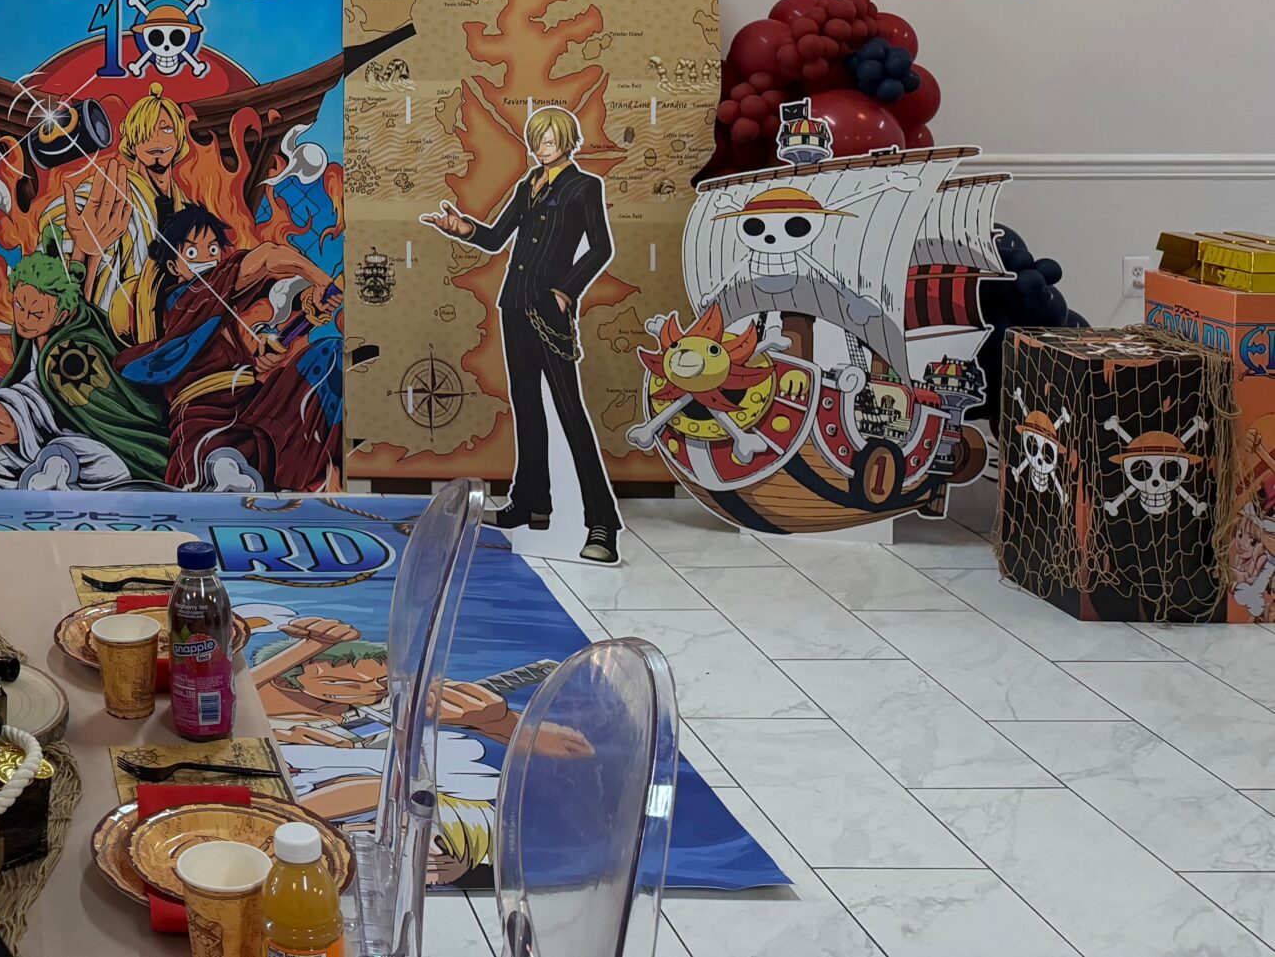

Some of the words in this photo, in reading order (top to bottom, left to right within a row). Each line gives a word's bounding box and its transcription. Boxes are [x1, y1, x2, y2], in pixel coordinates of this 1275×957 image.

[503, 97, 528, 106] Reverse
[532, 97, 567, 105] Mountain
[610, 101, 632, 111] Grand
[633, 101, 650, 109] Line
[656, 101, 687, 111] Paradise
[175, 640, 214, 656] snapple
